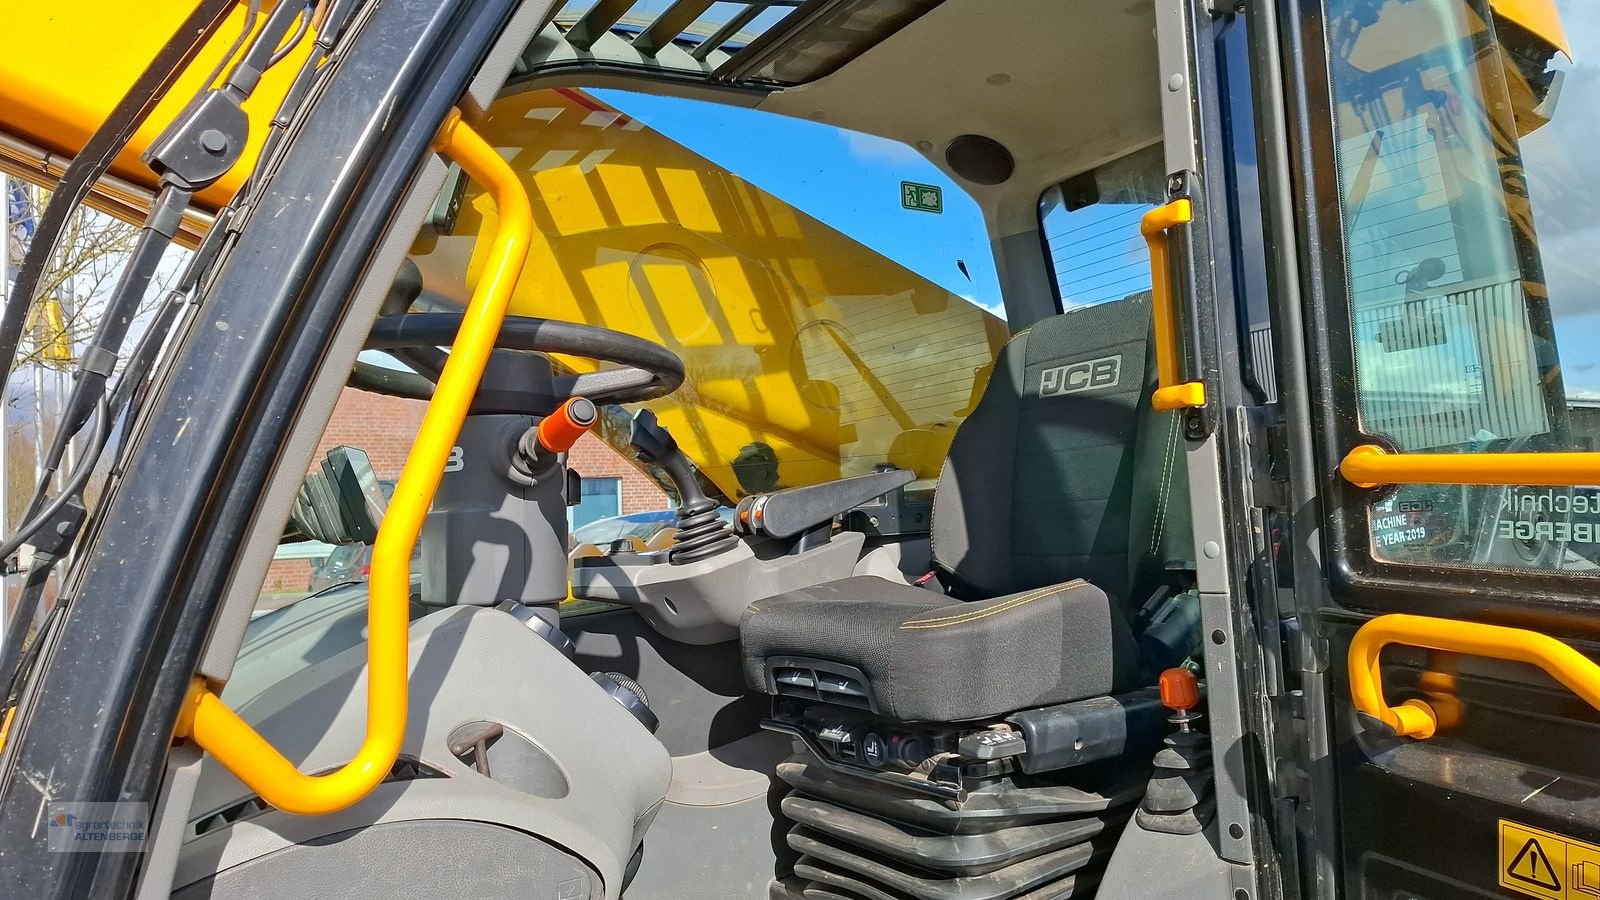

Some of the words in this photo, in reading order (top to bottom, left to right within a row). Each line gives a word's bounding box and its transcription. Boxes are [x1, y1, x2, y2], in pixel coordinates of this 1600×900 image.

[1040, 356, 1120, 397] JCB
[1383, 531, 1405, 546] YEAR
[1406, 527, 1425, 541] 2019
